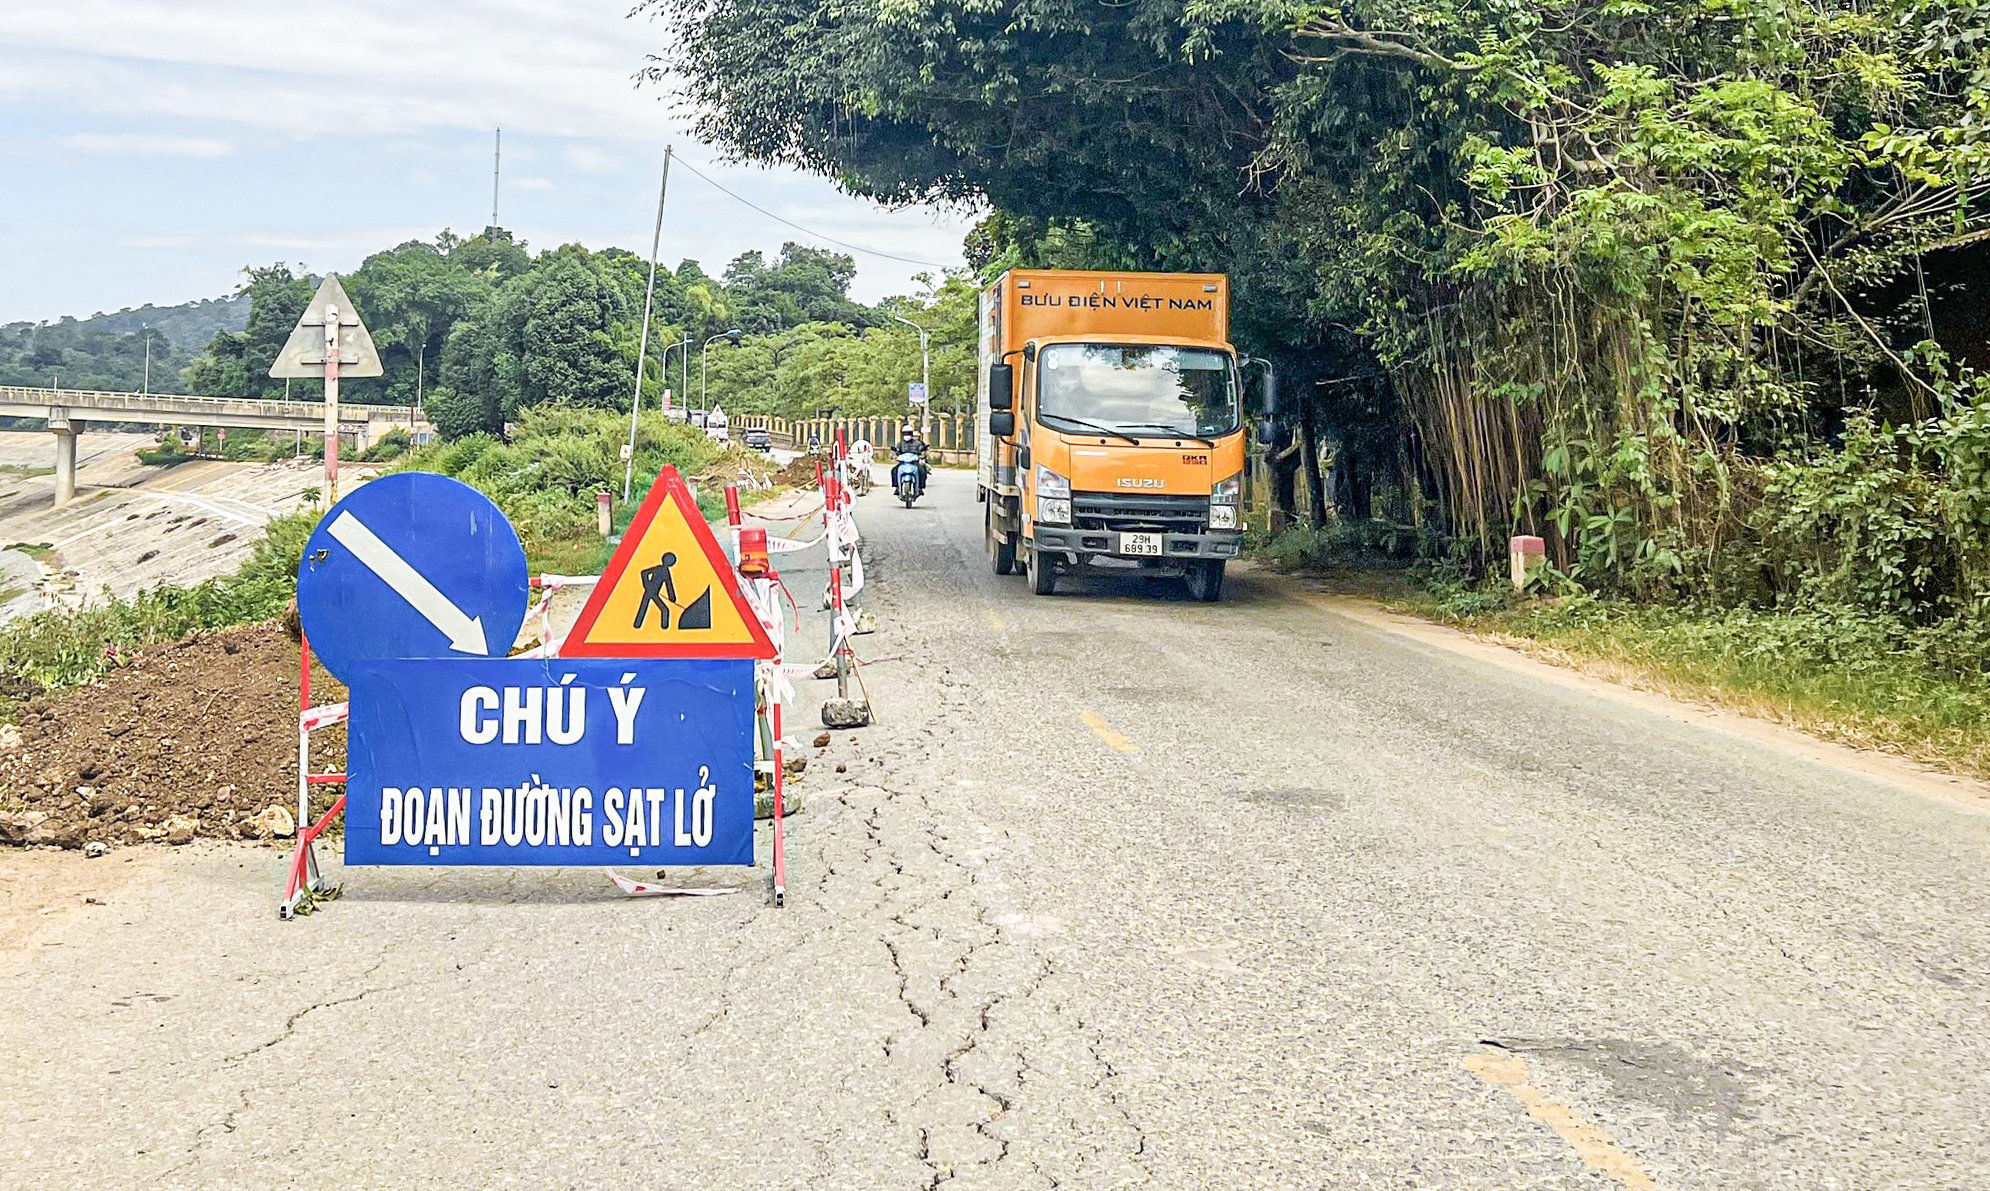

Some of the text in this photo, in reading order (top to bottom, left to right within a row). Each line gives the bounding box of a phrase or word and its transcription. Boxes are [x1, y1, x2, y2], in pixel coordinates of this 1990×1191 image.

[1020, 292, 1212, 312] BƯU ĐIỆN VIỆT NAM
[1116, 477, 1165, 489] ISUZU
[1132, 534, 1151, 544] 29H
[459, 672, 646, 746] CHÚ Ý
[380, 765, 716, 857] ĐOẠN ĐƯỜNG SẠT LỞ
